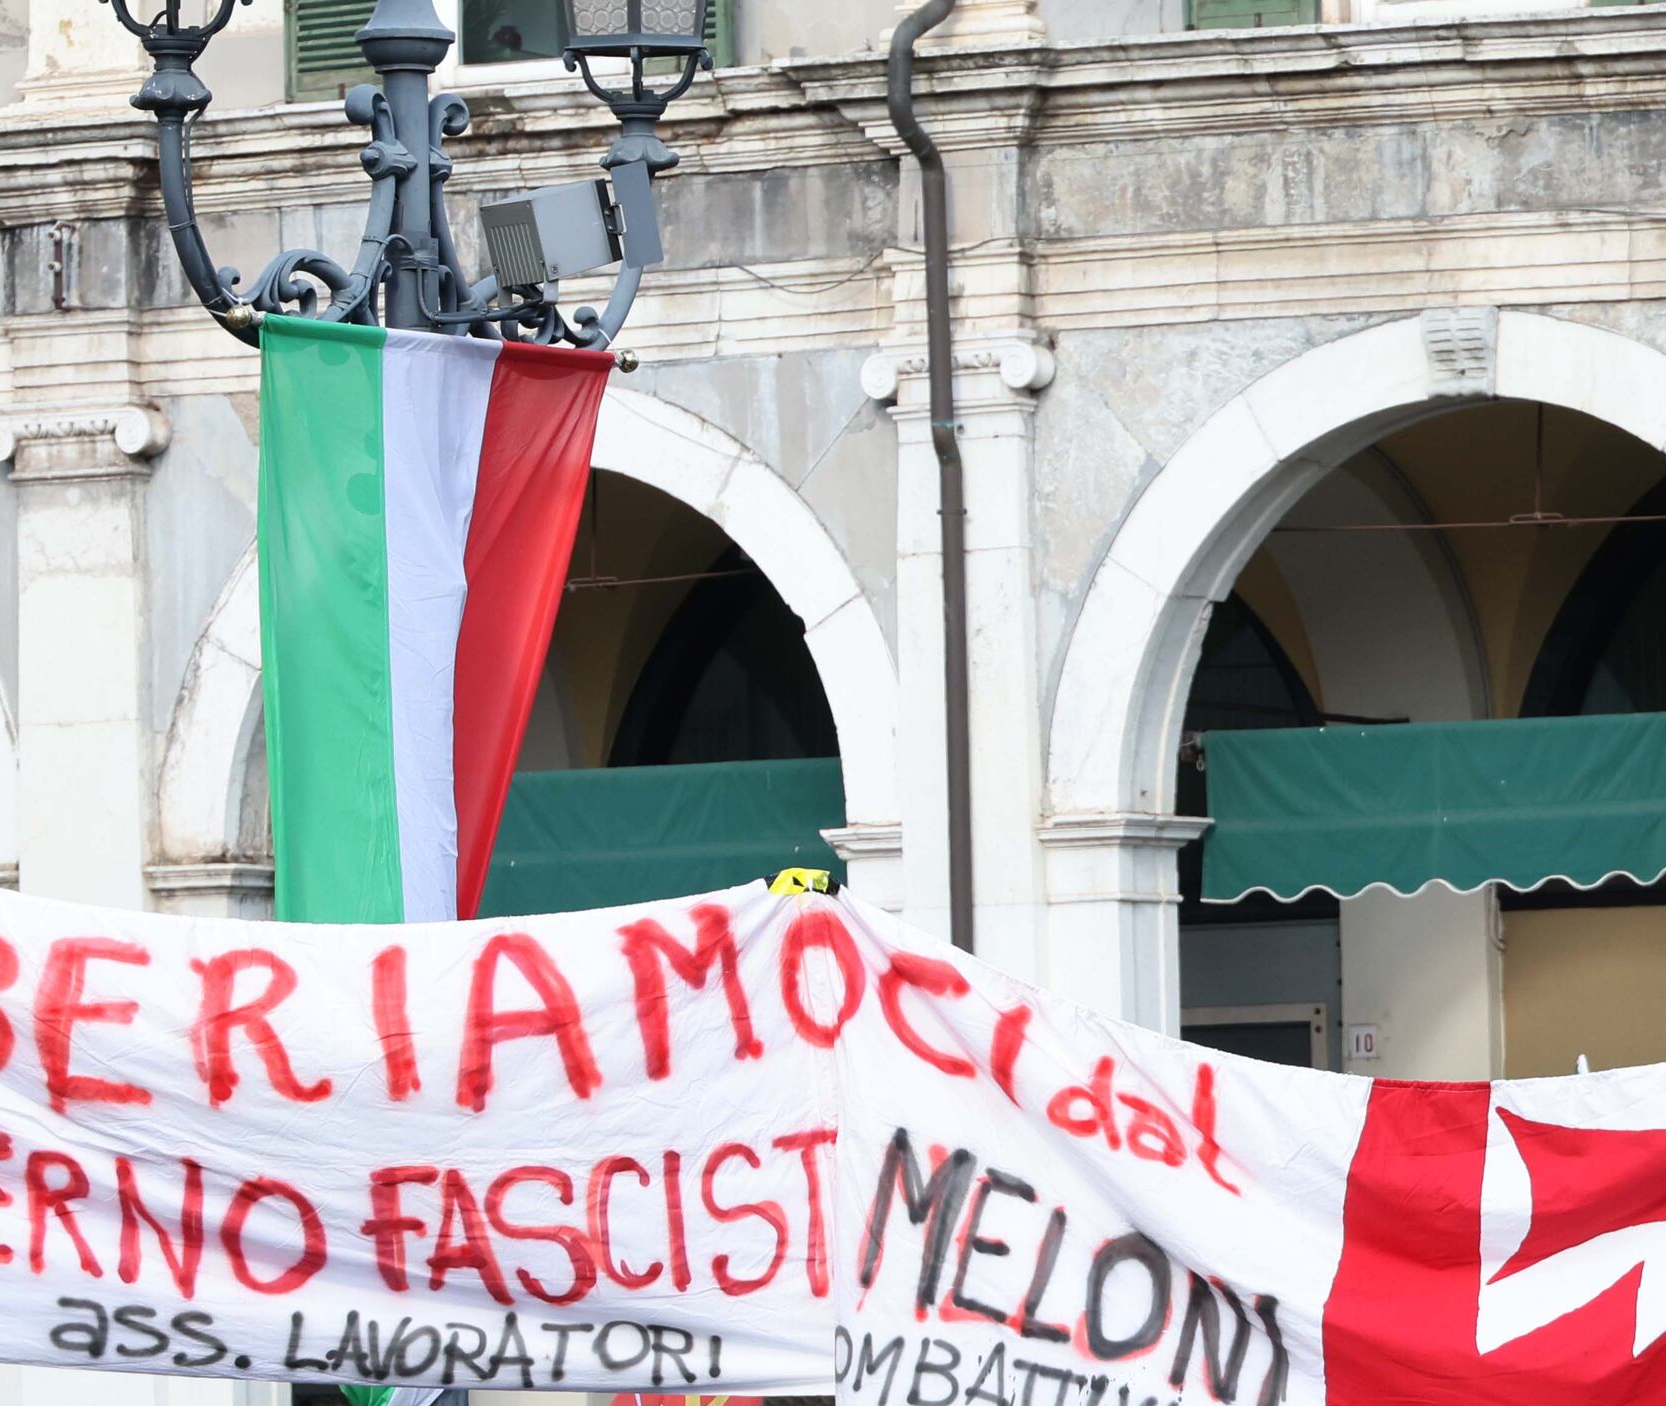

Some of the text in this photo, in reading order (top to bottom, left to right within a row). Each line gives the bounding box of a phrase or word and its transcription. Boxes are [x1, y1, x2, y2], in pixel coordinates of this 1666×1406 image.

[1355, 1033, 1374, 1053] 10
[1046, 1052, 1243, 1197] dal
[361, 1126, 836, 1308] FASCIST
[50, 1297, 252, 1371] ass.
[286, 1309, 724, 1387] LAVORATORI
